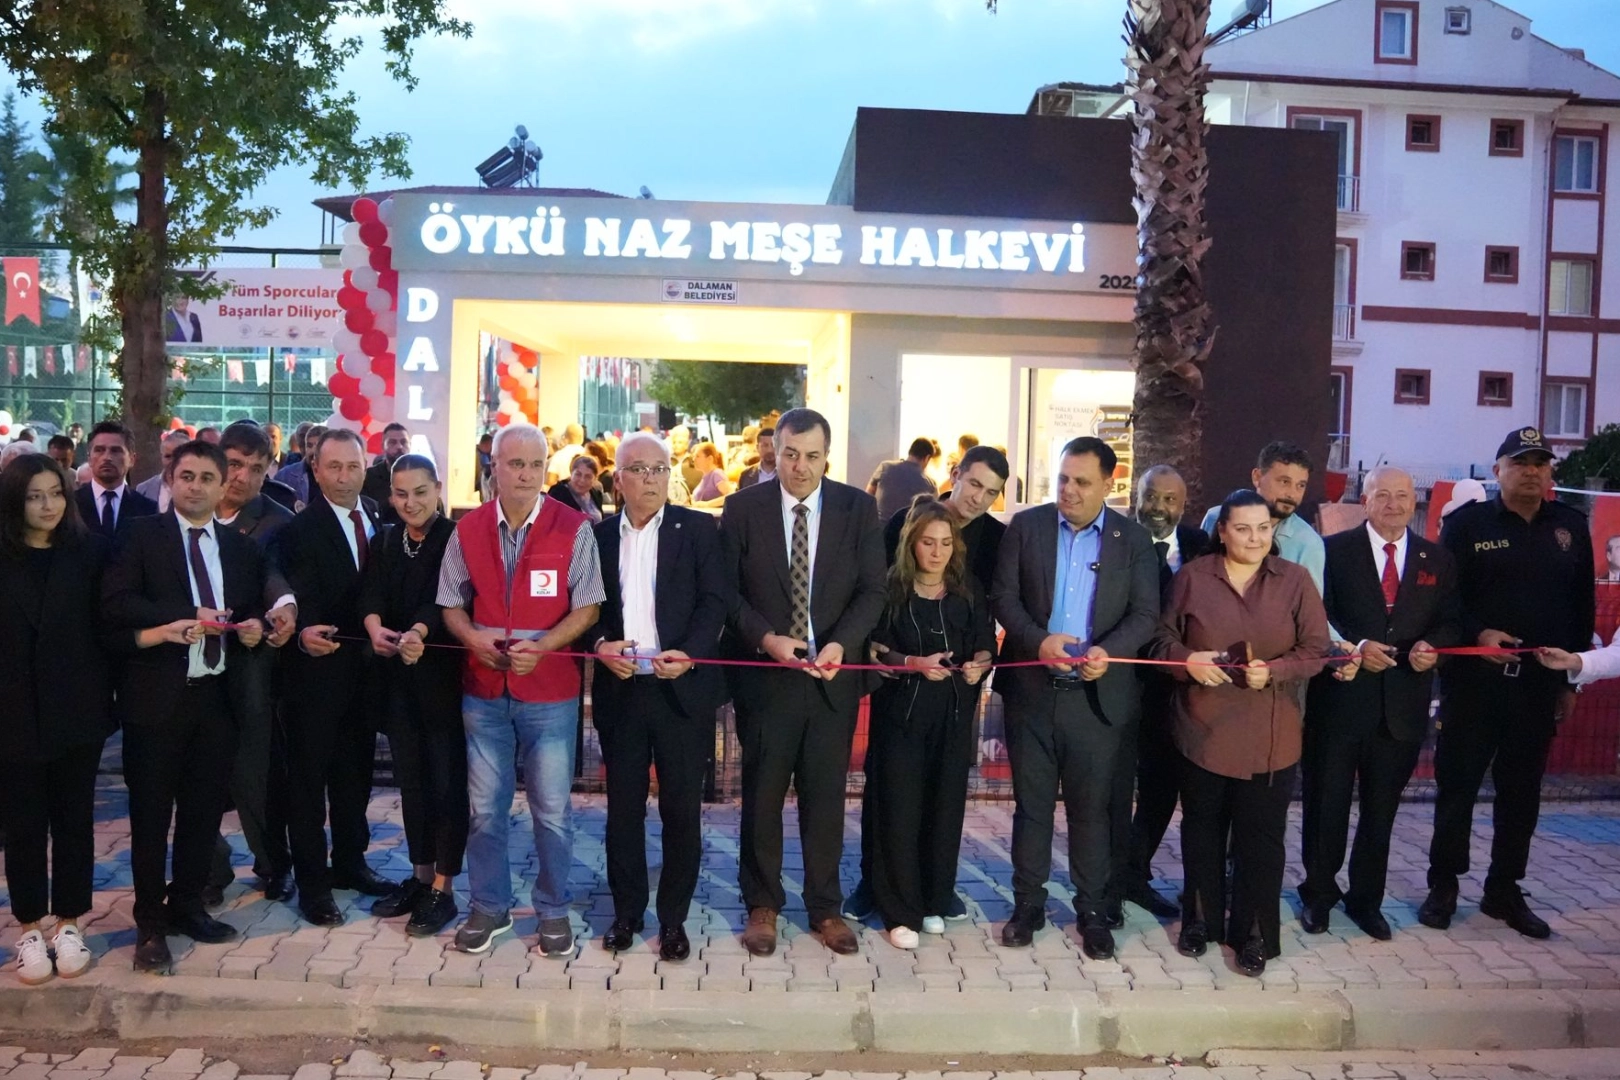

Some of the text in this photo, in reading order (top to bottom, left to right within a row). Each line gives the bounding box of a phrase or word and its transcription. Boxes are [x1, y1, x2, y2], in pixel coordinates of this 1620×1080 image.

[421, 202, 1086, 276] ÖYKÜ NAZ MEŞE HALKEVİ
[263, 285, 338, 300] Sporcular
[687, 282, 733, 290] DALAMAN
[684, 291, 736, 300] BELEDİYESİ
[218, 304, 343, 321] Başarılar Diliyor
